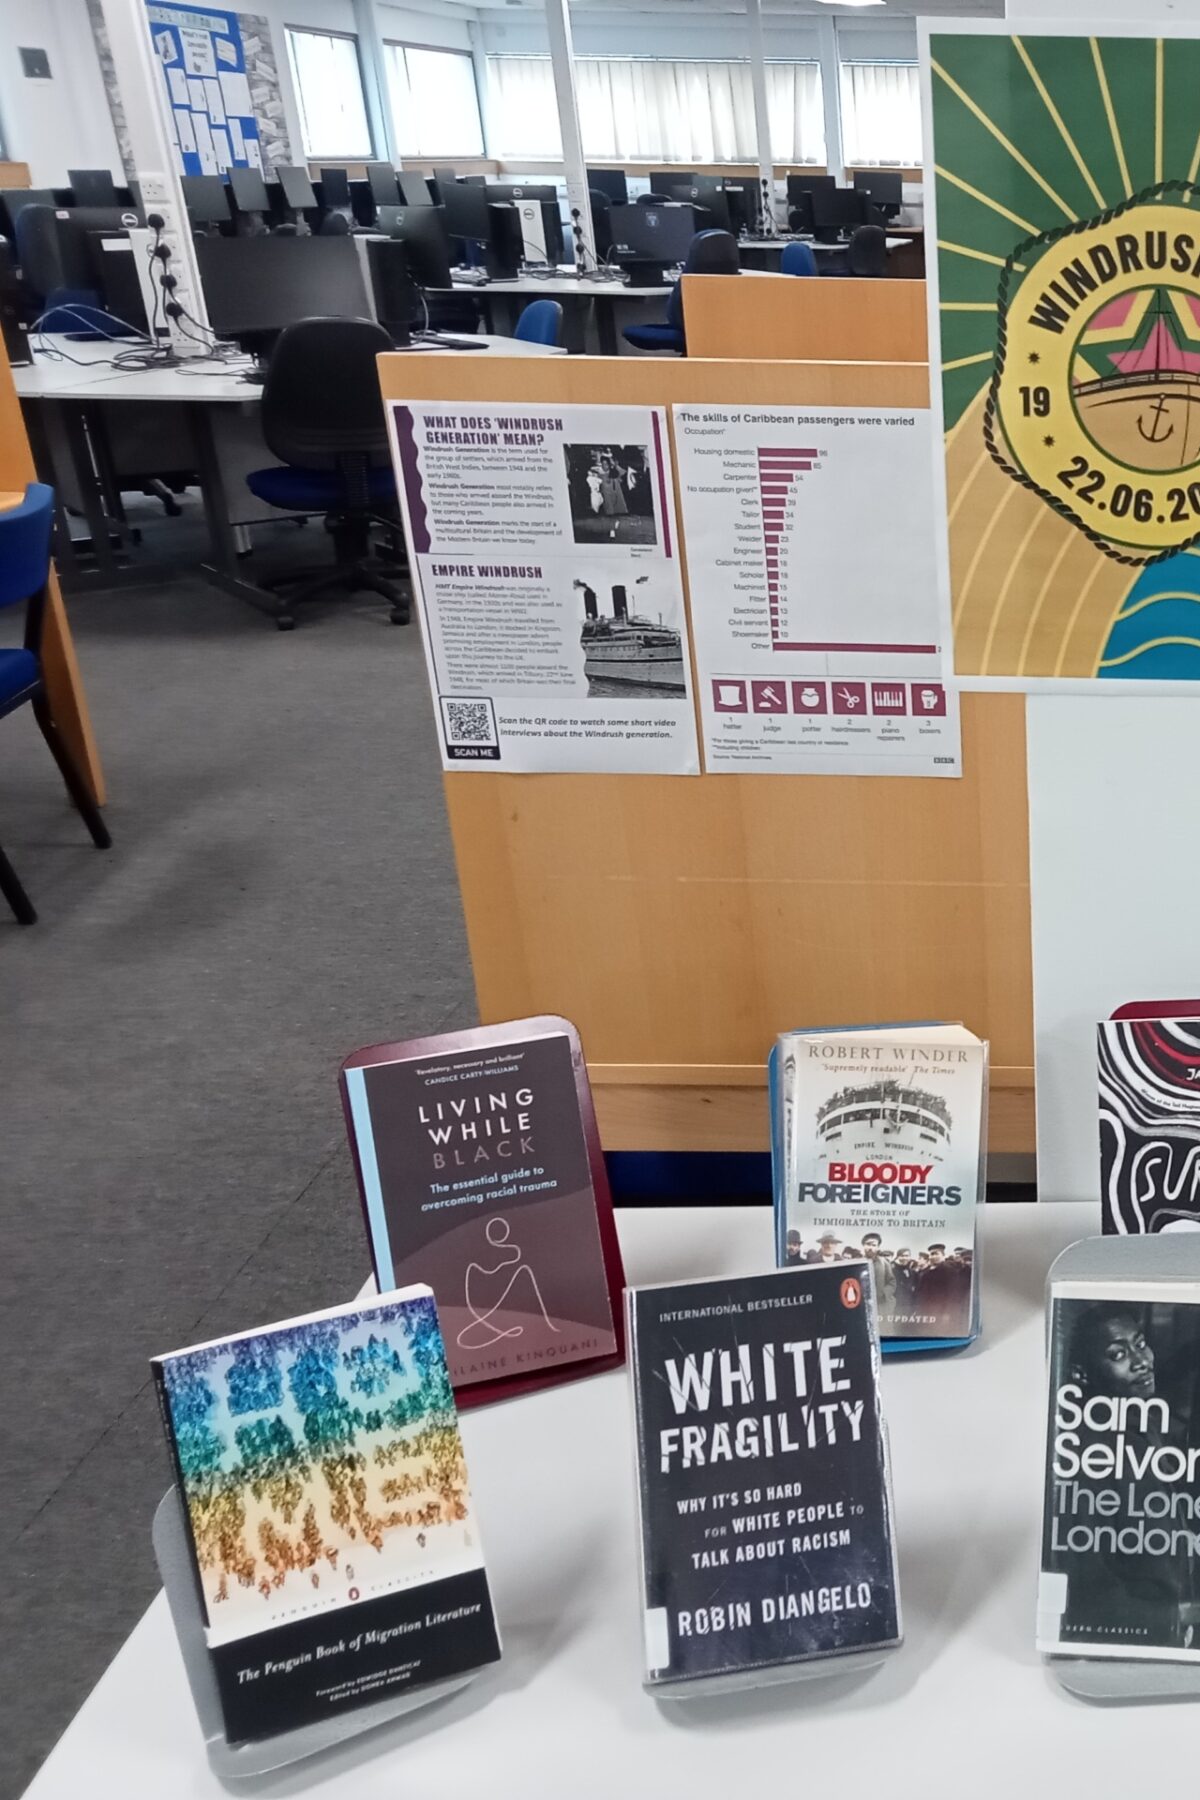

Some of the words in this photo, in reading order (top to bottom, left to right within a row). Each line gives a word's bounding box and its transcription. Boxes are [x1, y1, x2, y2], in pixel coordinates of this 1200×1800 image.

[1019, 386, 1051, 417] 19
[424, 416, 457, 429] WHAT
[460, 416, 491, 429] DOES
[494, 417, 563, 431] 'WINDRUSH
[681, 413, 699, 422] The
[703, 413, 728, 422] skills
[731, 414, 740, 423] of
[743, 414, 794, 424] Caribbean
[797, 416, 855, 426] passengers
[884, 416, 914, 426] varied
[426, 432, 500, 445] GENERATION'
[504, 433, 544, 445] MEAN?
[432, 564, 474, 577] EMPIRE
[477, 565, 542, 578] WINDRUSH
[499, 716, 518, 725] Scan
[520, 717, 532, 726] the
[534, 718, 546, 727] QR
[549, 718, 568, 726] code
[580, 718, 605, 726] watch
[654, 718, 676, 726] video
[543, 729, 567, 737] about
[585, 730, 624, 738] Windrush
[626, 730, 672, 739] generation.
[455, 748, 479, 757] SCAN
[480, 749, 493, 757] ME
[809, 1045, 884, 1060] ROBERT
[893, 1047, 968, 1062] WINDER
[419, 1088, 534, 1123] LIVING
[428, 1113, 531, 1145] WHILE
[433, 1137, 535, 1169] BLACK
[430, 1183, 449, 1194] The
[452, 1174, 498, 1190] essential
[501, 1169, 530, 1184] guide
[534, 1167, 544, 1176] to
[828, 1162, 933, 1184] BLOODY
[421, 1193, 483, 1212] overcoming
[486, 1185, 517, 1200] racial
[519, 1179, 557, 1195] trauma
[798, 1183, 962, 1206] FOREIGNERS
[814, 1218, 884, 1227] IMMIGRATION
[886, 1219, 900, 1227] TO
[903, 1219, 945, 1228] BRITAIN
[659, 1305, 743, 1322] INTERNATIONAL
[747, 1294, 813, 1312] BESTSELLER
[665, 1335, 850, 1415] WHITE
[1055, 1384, 1170, 1434] Sam
[659, 1400, 864, 1473] FRAGILITY
[677, 1497, 706, 1515] WHY
[712, 1493, 738, 1509] IT'S
[744, 1490, 761, 1504] SO
[767, 1482, 802, 1501] HARD
[1054, 1480, 1120, 1516] The
[704, 1526, 727, 1538] FOR
[732, 1512, 780, 1534] WHITE
[787, 1502, 844, 1526] PEOPLE
[850, 1504, 864, 1515] TO
[691, 1550, 729, 1569] TALK
[735, 1540, 786, 1563] ABOUT
[792, 1529, 850, 1552] RACISM
[678, 1602, 751, 1636] ROBIN
[762, 1582, 871, 1623] DIANGELO
[237, 1668, 260, 1684] The
[265, 1653, 312, 1676] Penguin
[316, 1641, 345, 1660] Book
[349, 1634, 363, 1652] of
[365, 1619, 421, 1645] Migration
[426, 1603, 481, 1627] Literature
